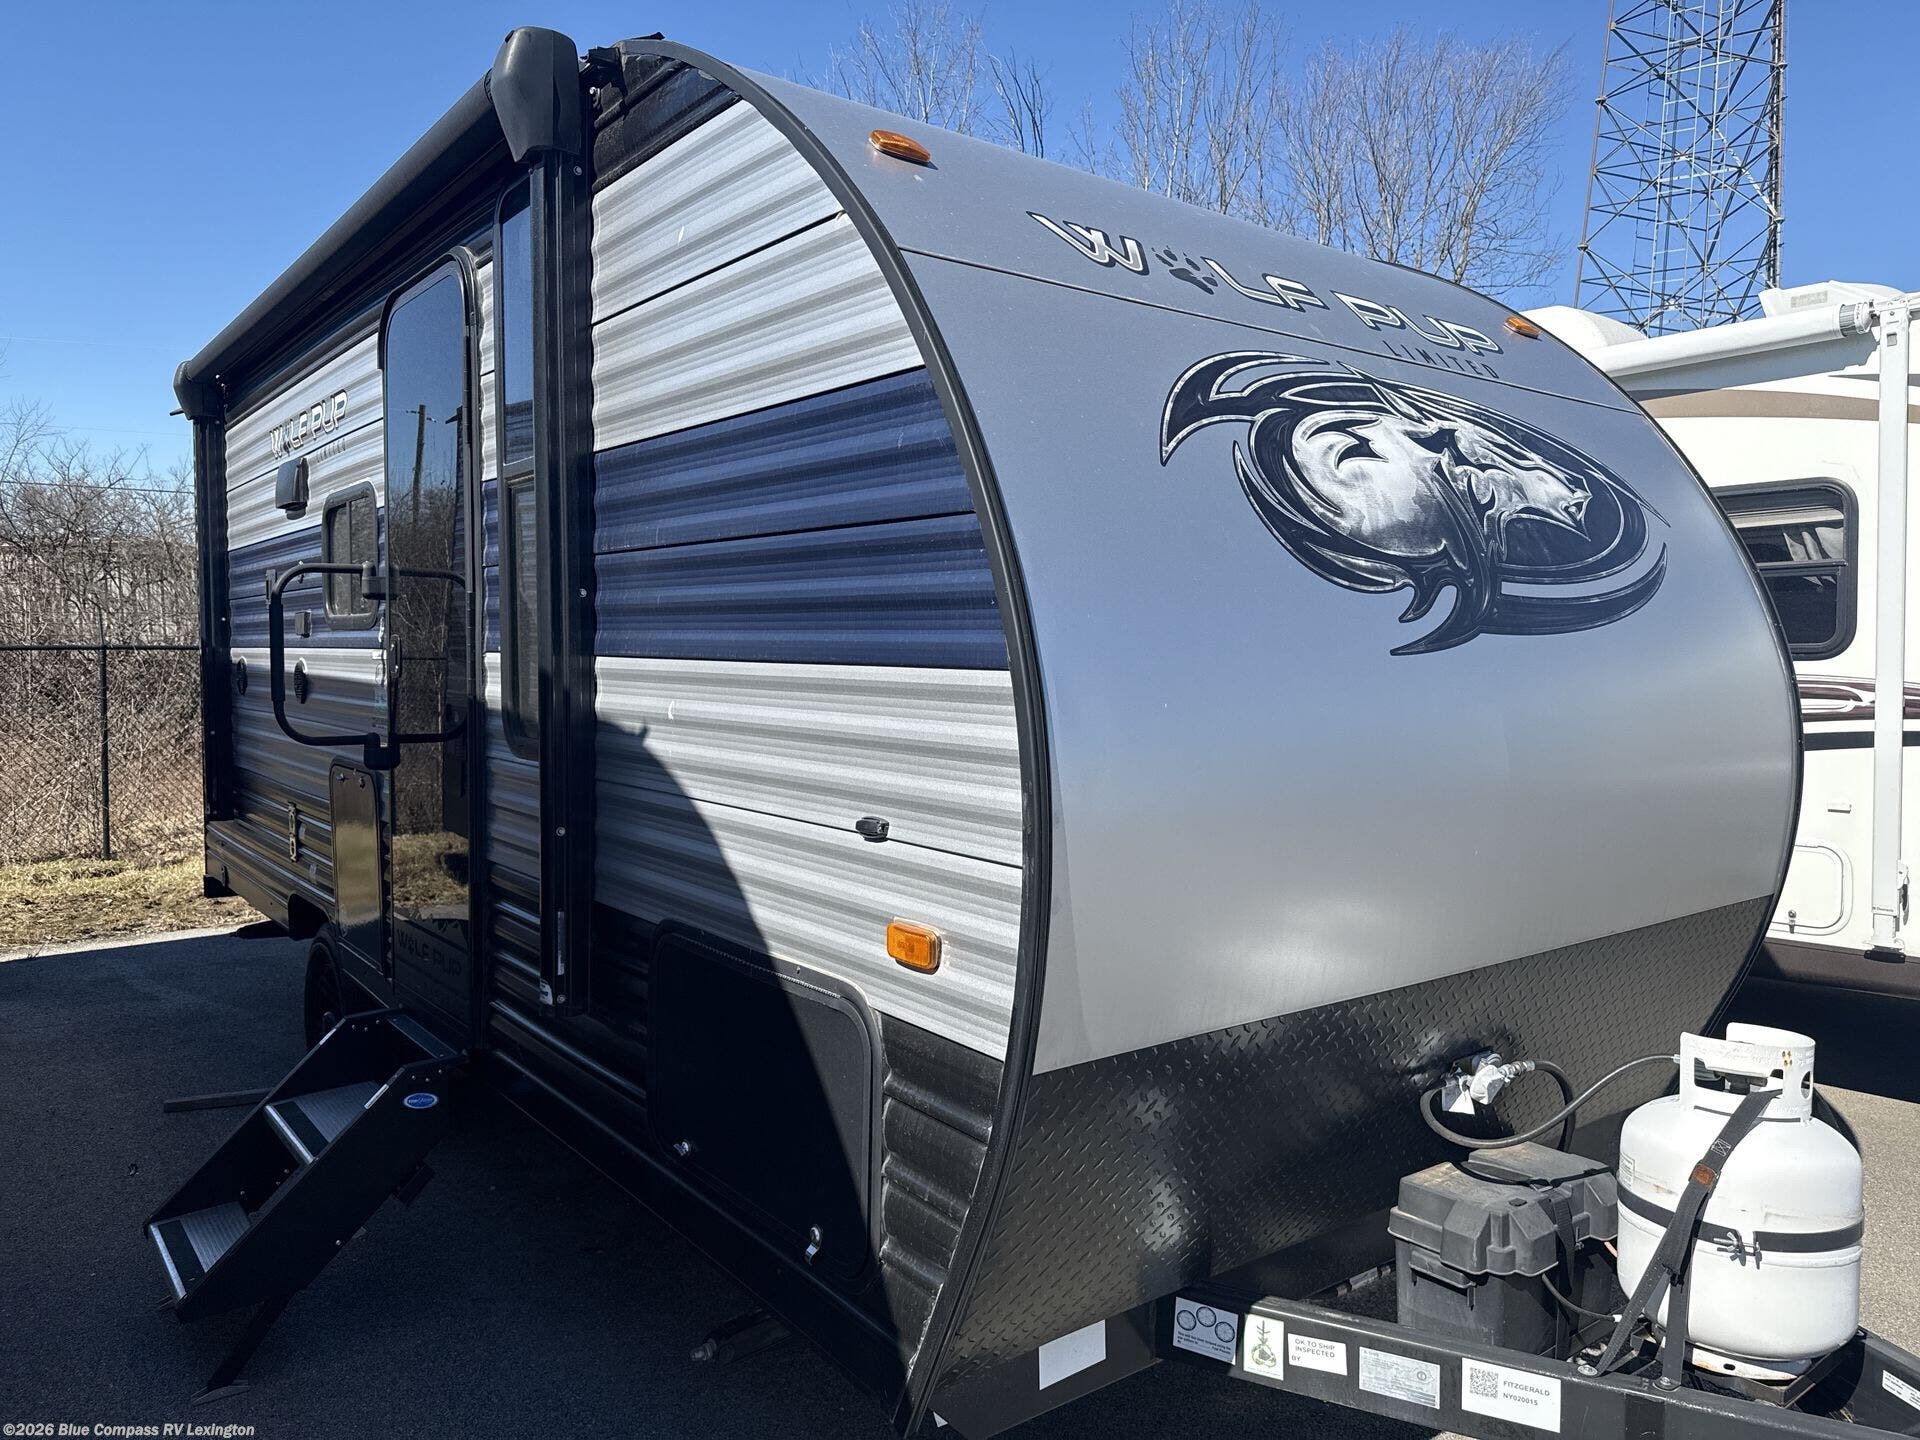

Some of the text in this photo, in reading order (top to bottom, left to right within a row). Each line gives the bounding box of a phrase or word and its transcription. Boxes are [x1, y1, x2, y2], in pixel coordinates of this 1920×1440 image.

[1331, 289, 1504, 356] PUP
[1382, 339, 1500, 379] LIMITED
[310, 388, 347, 441] PUP
[1295, 1346, 1335, 1358] INSPECTED
[1307, 1340, 1317, 1348] TO
[1503, 1380, 1550, 1397] FITZGERALD
